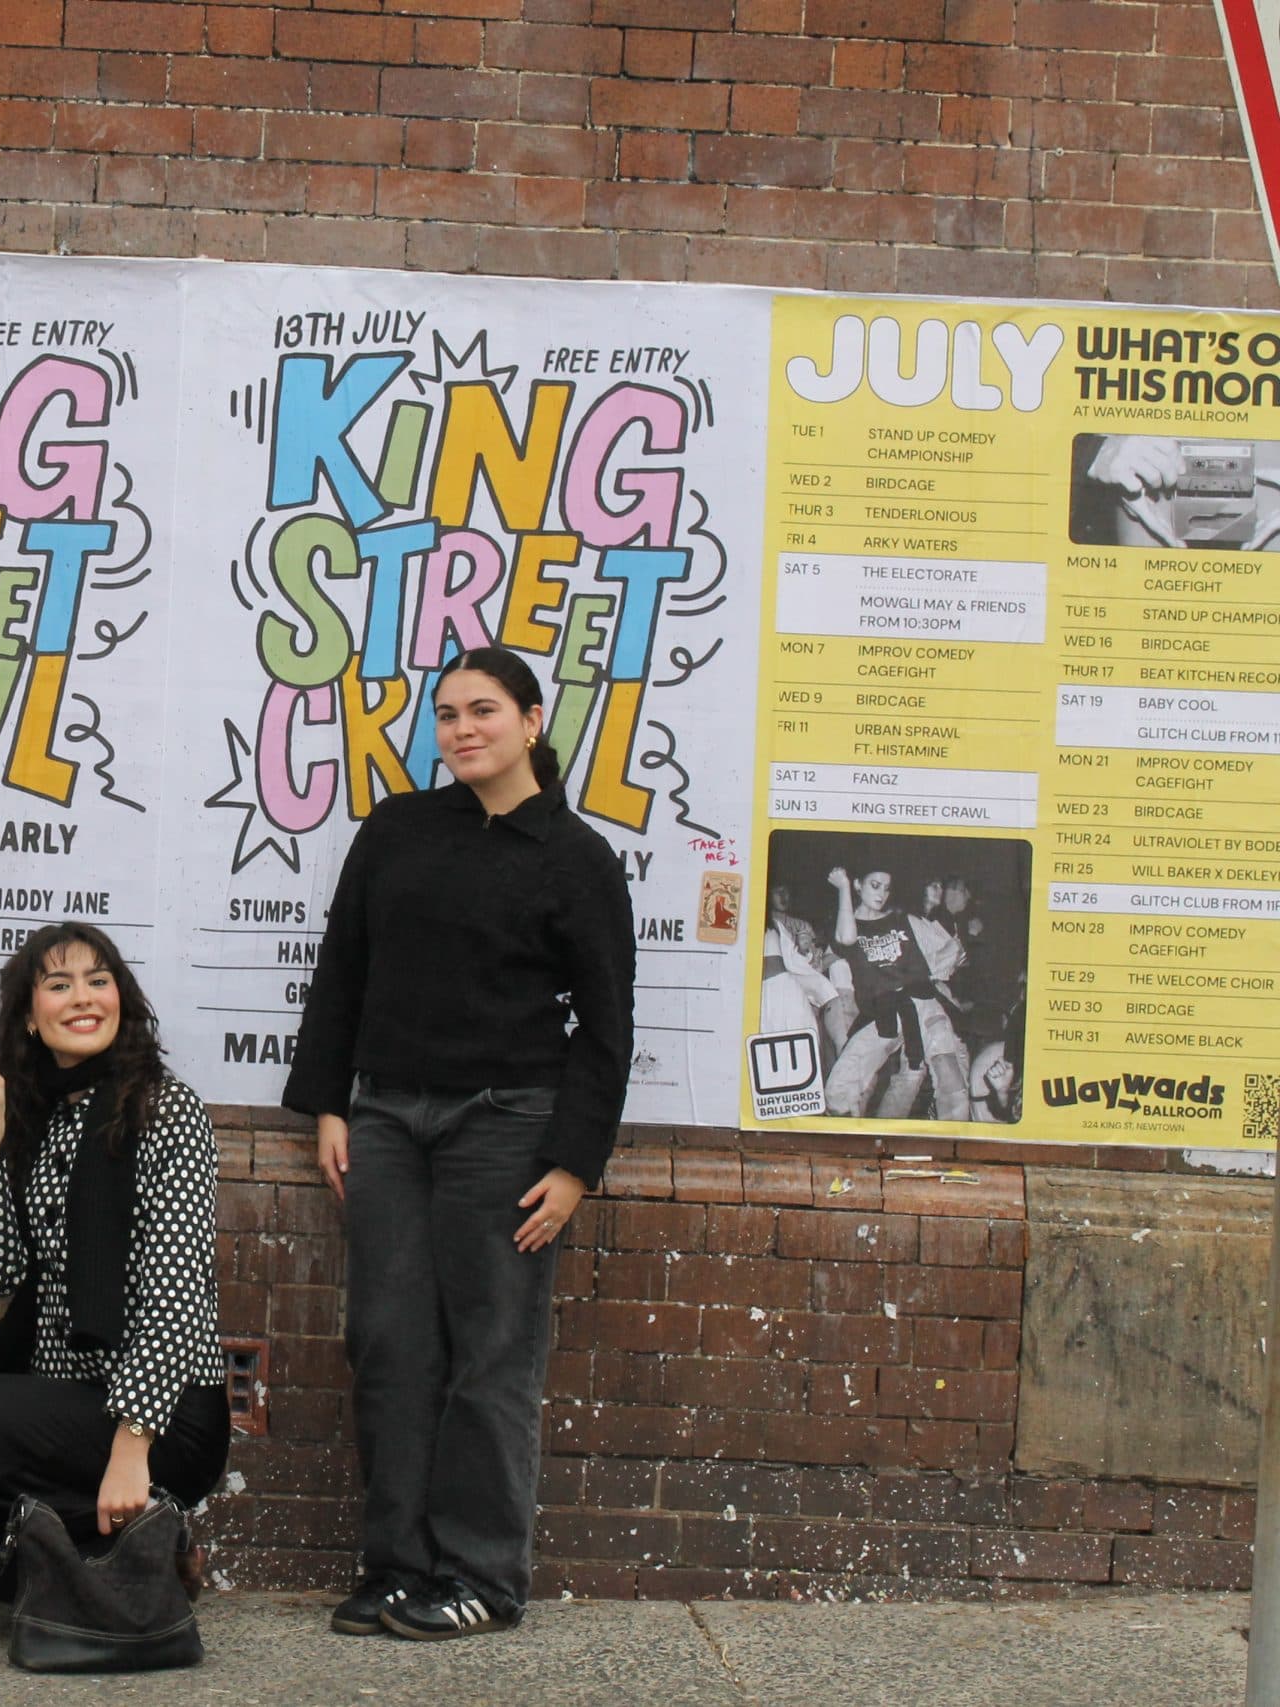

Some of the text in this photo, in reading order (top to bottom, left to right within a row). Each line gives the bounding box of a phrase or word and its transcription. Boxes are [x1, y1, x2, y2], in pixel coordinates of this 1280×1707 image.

[32, 321, 114, 348] ENTRY
[274, 311, 426, 348] 13TH JULY
[1078, 326, 1240, 365] WHAT'S
[543, 349, 690, 375] FREE ENTRY
[786, 314, 1064, 412] JULY
[1075, 367, 1166, 402] THIS
[1073, 406, 1248, 422] AT WAYWARDS BALLROOM
[868, 428, 996, 444] STAND UP COMEDY
[267, 351, 688, 551] KING
[868, 448, 974, 463] CHAMPIONSHIP
[866, 478, 936, 491] BIRDCAGE
[866, 507, 977, 522] TENDERLONIOUS
[864, 537, 958, 552] ARKY WATERS
[863, 566, 977, 582] THE ELECTORATE
[1144, 560, 1262, 574] IMPROV COMEDY
[1144, 579, 1223, 593] CAGEFIGHT
[256, 514, 692, 689] STREET
[860, 596, 1026, 614] MOWGLI MAY & FRIENDS
[860, 616, 961, 630] FROM 10:30PM
[1141, 668, 1235, 682] BEAT KITCHEN
[1139, 697, 1218, 711] BABY COOL
[855, 724, 960, 739] URBAN SPRAWL
[1138, 727, 1226, 741] GLITCH CLUB
[877, 745, 948, 757] HISTAMINE
[775, 770, 898, 785] SAT 12 FANGZ
[775, 800, 990, 819] SUN 13 KING STREET CRAWL
[688, 839, 725, 851] TAKE
[1133, 835, 1241, 850] ULTRAVIOLET BY
[705, 851, 725, 862] ME
[1132, 865, 1210, 879] WILL BAKER
[63, 892, 110, 914] JANE
[229, 899, 306, 923] STUMPS
[638, 918, 684, 941] JANE
[1128, 974, 1274, 990] THE WELCOME CHOIR
[1125, 1033, 1243, 1048] AWESOME BLACK
[757, 1091, 820, 1106] WAYWARDS
[760, 1102, 820, 1116] BALLROOM
[1143, 1105, 1223, 1119] BALLROOM
[1100, 1122, 1121, 1130] KING
[1136, 1122, 1185, 1132] NEWTOWN
